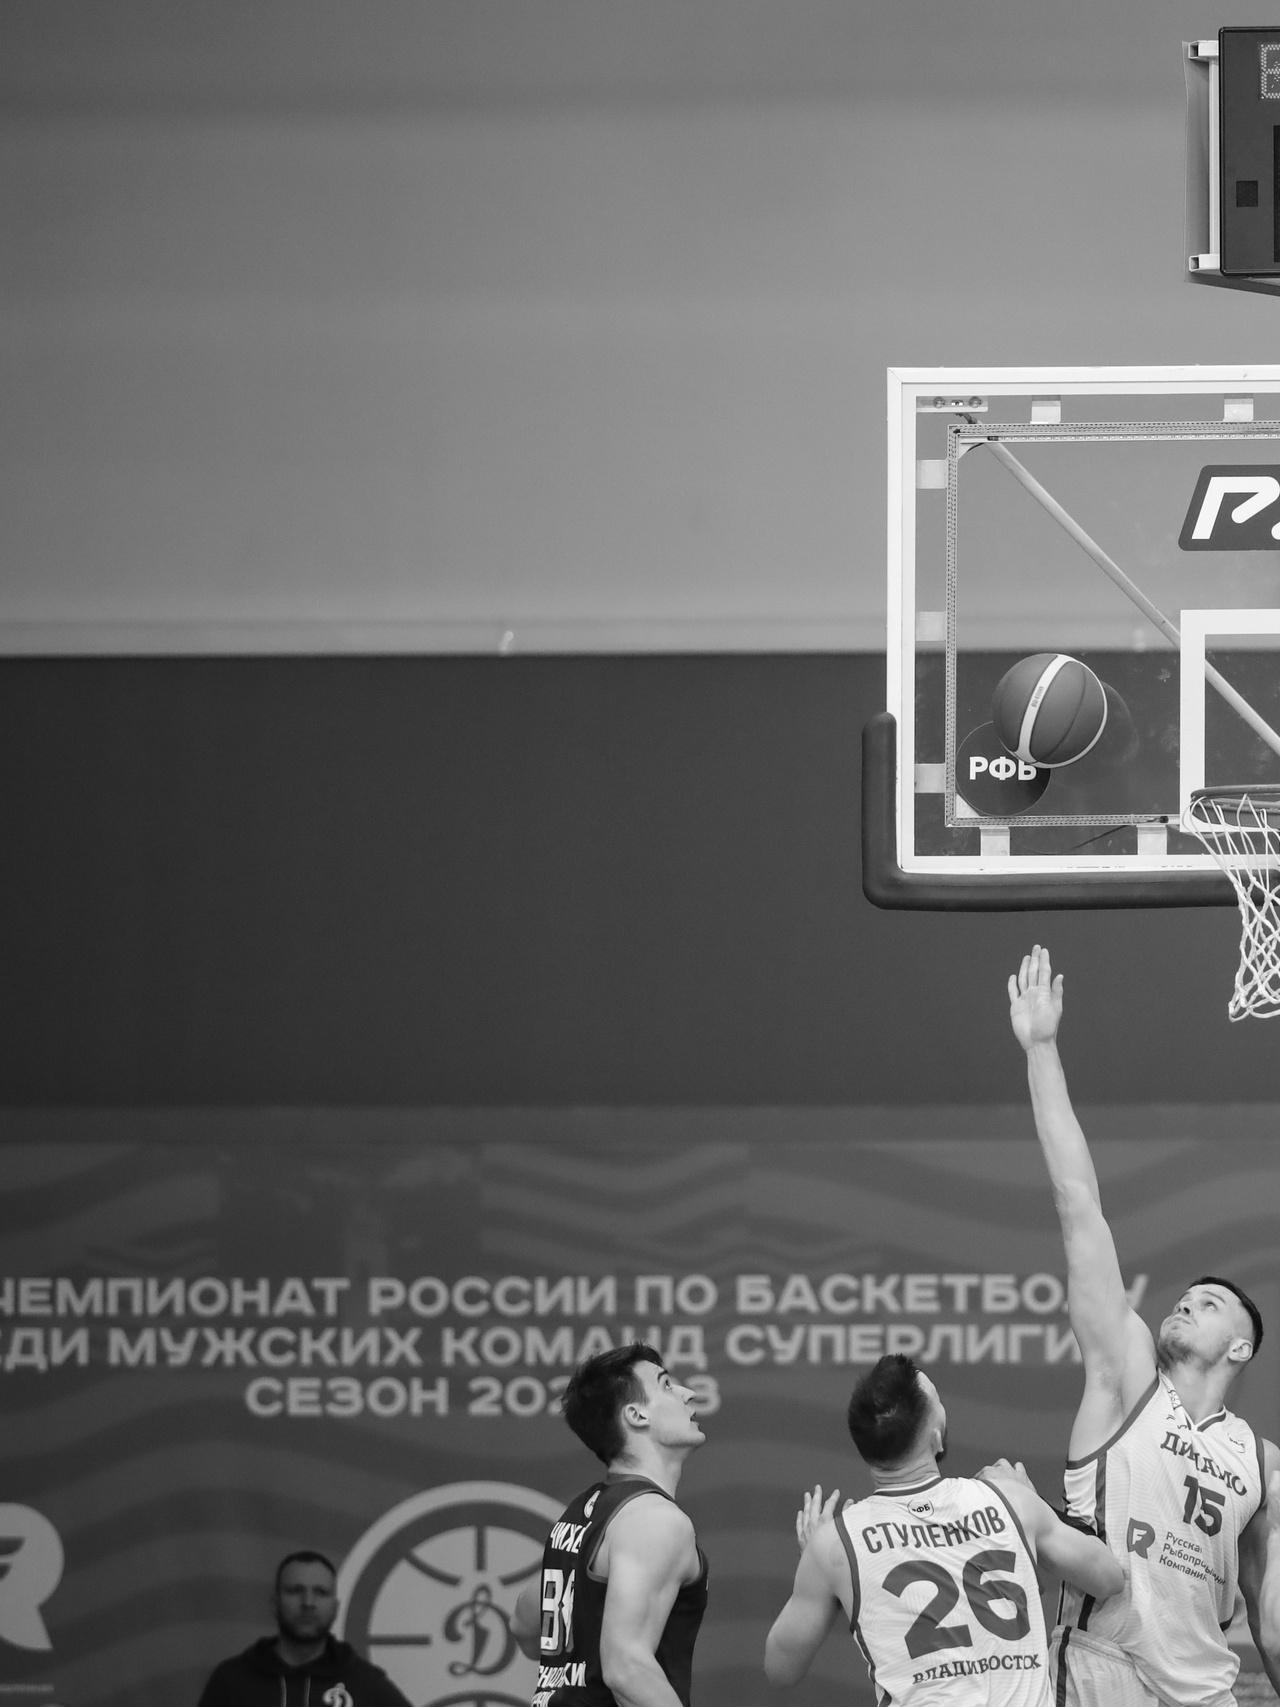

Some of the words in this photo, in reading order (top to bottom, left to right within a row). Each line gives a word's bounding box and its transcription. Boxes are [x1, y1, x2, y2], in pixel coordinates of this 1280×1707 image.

[368, 1275, 618, 1317] РОССИИ
[635, 1274, 718, 1315] ПО
[736, 1272, 1148, 1315] БАСКЕТБОУ
[0, 1327, 89, 1371] ДИ
[109, 1326, 422, 1367] МУЖСКИХ
[726, 1324, 1083, 1365] СУПЕРЛИГИ
[245, 1376, 449, 1417] СЕЗОН
[861, 1505, 1006, 1554] СТУЛЕНКОВ
[1183, 1474, 1226, 1537] 15
[882, 1549, 1031, 1660] 26
